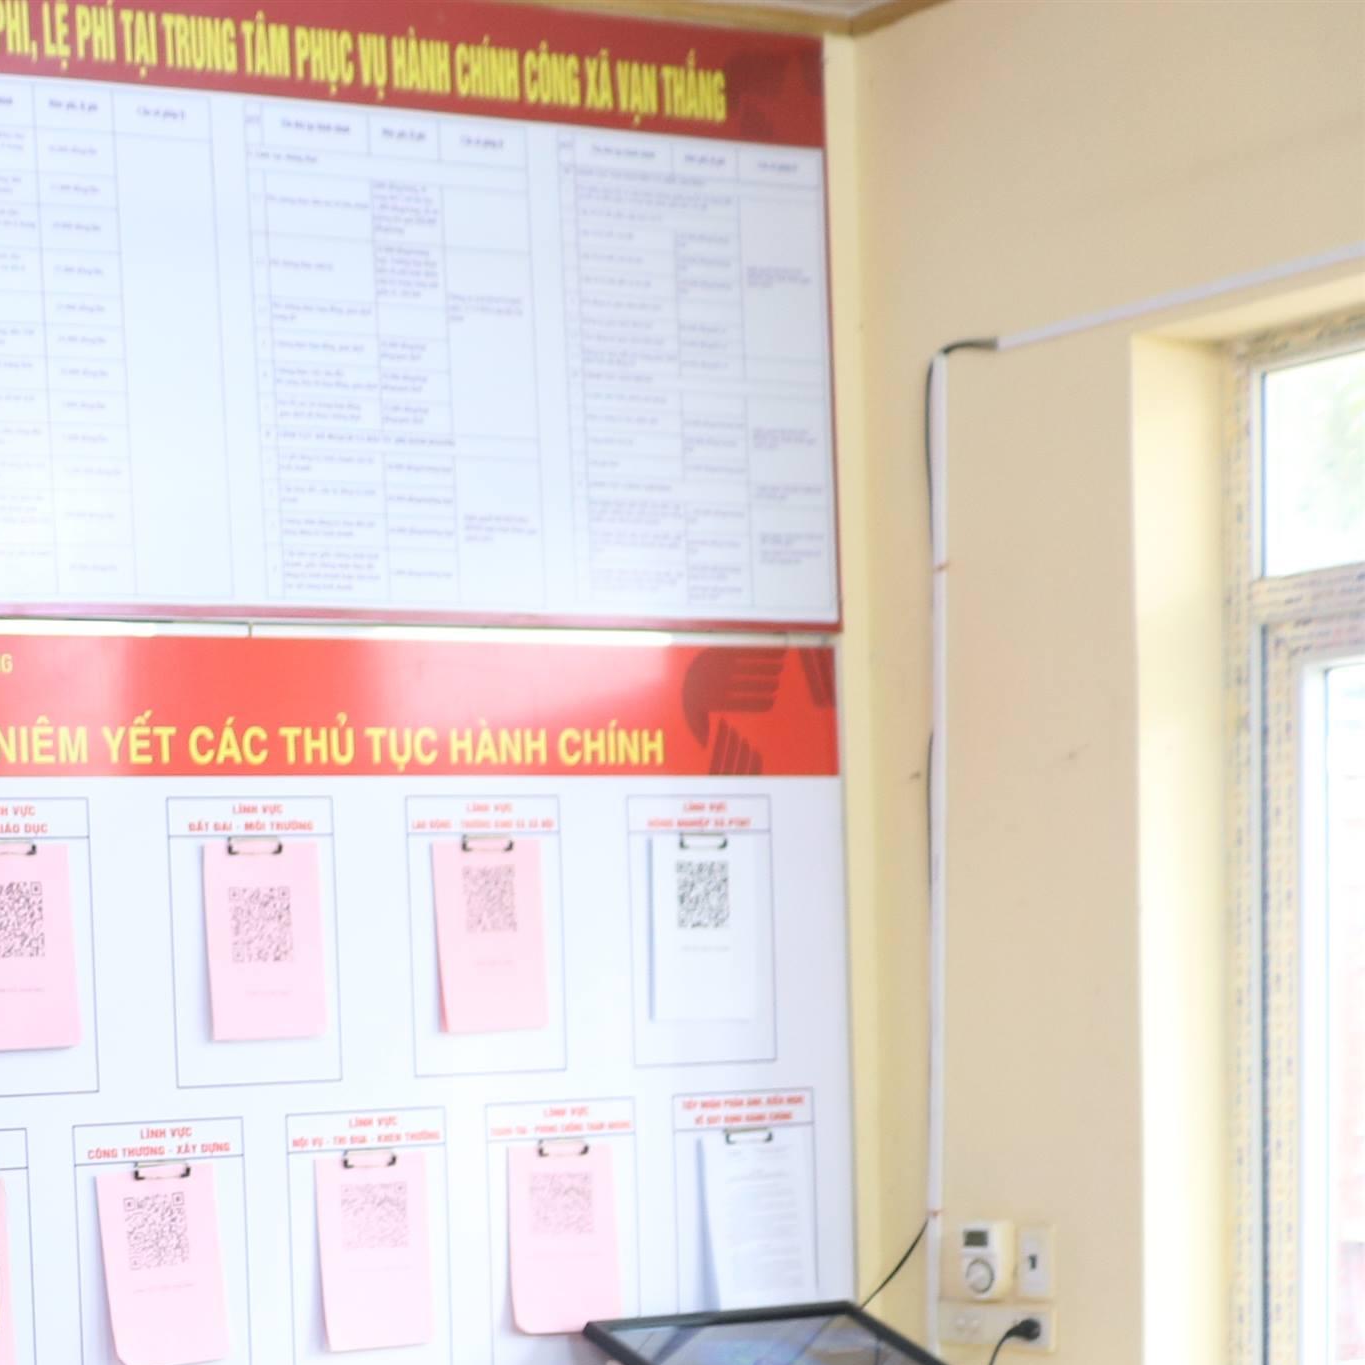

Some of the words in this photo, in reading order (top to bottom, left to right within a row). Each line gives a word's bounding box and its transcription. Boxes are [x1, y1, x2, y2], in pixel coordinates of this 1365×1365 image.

[43, 4, 70, 70] LỆ
[76, 0, 116, 64] PHÍ
[121, 11, 157, 78] TẠI
[163, 14, 236, 73] TRUNG
[241, 12, 291, 81] TÂM
[296, 27, 354, 94] PHỤC
[359, 33, 388, 100] VỤ
[392, 27, 450, 95] HÀNH
[455, 37, 519, 101] CHÍNH
[525, 42, 580, 107] CÔNG
[585, 49, 613, 110] XÃ
[617, 61, 656, 127] VẠN
[663, 49, 726, 122] THẮNG
[103, 711, 176, 765] YẾT
[189, 718, 268, 766] CÁC
[279, 712, 355, 765] THỦ
[365, 726, 438, 773] TỤC
[450, 718, 546, 766] HÀNH
[558, 720, 664, 766] CHÍNH
